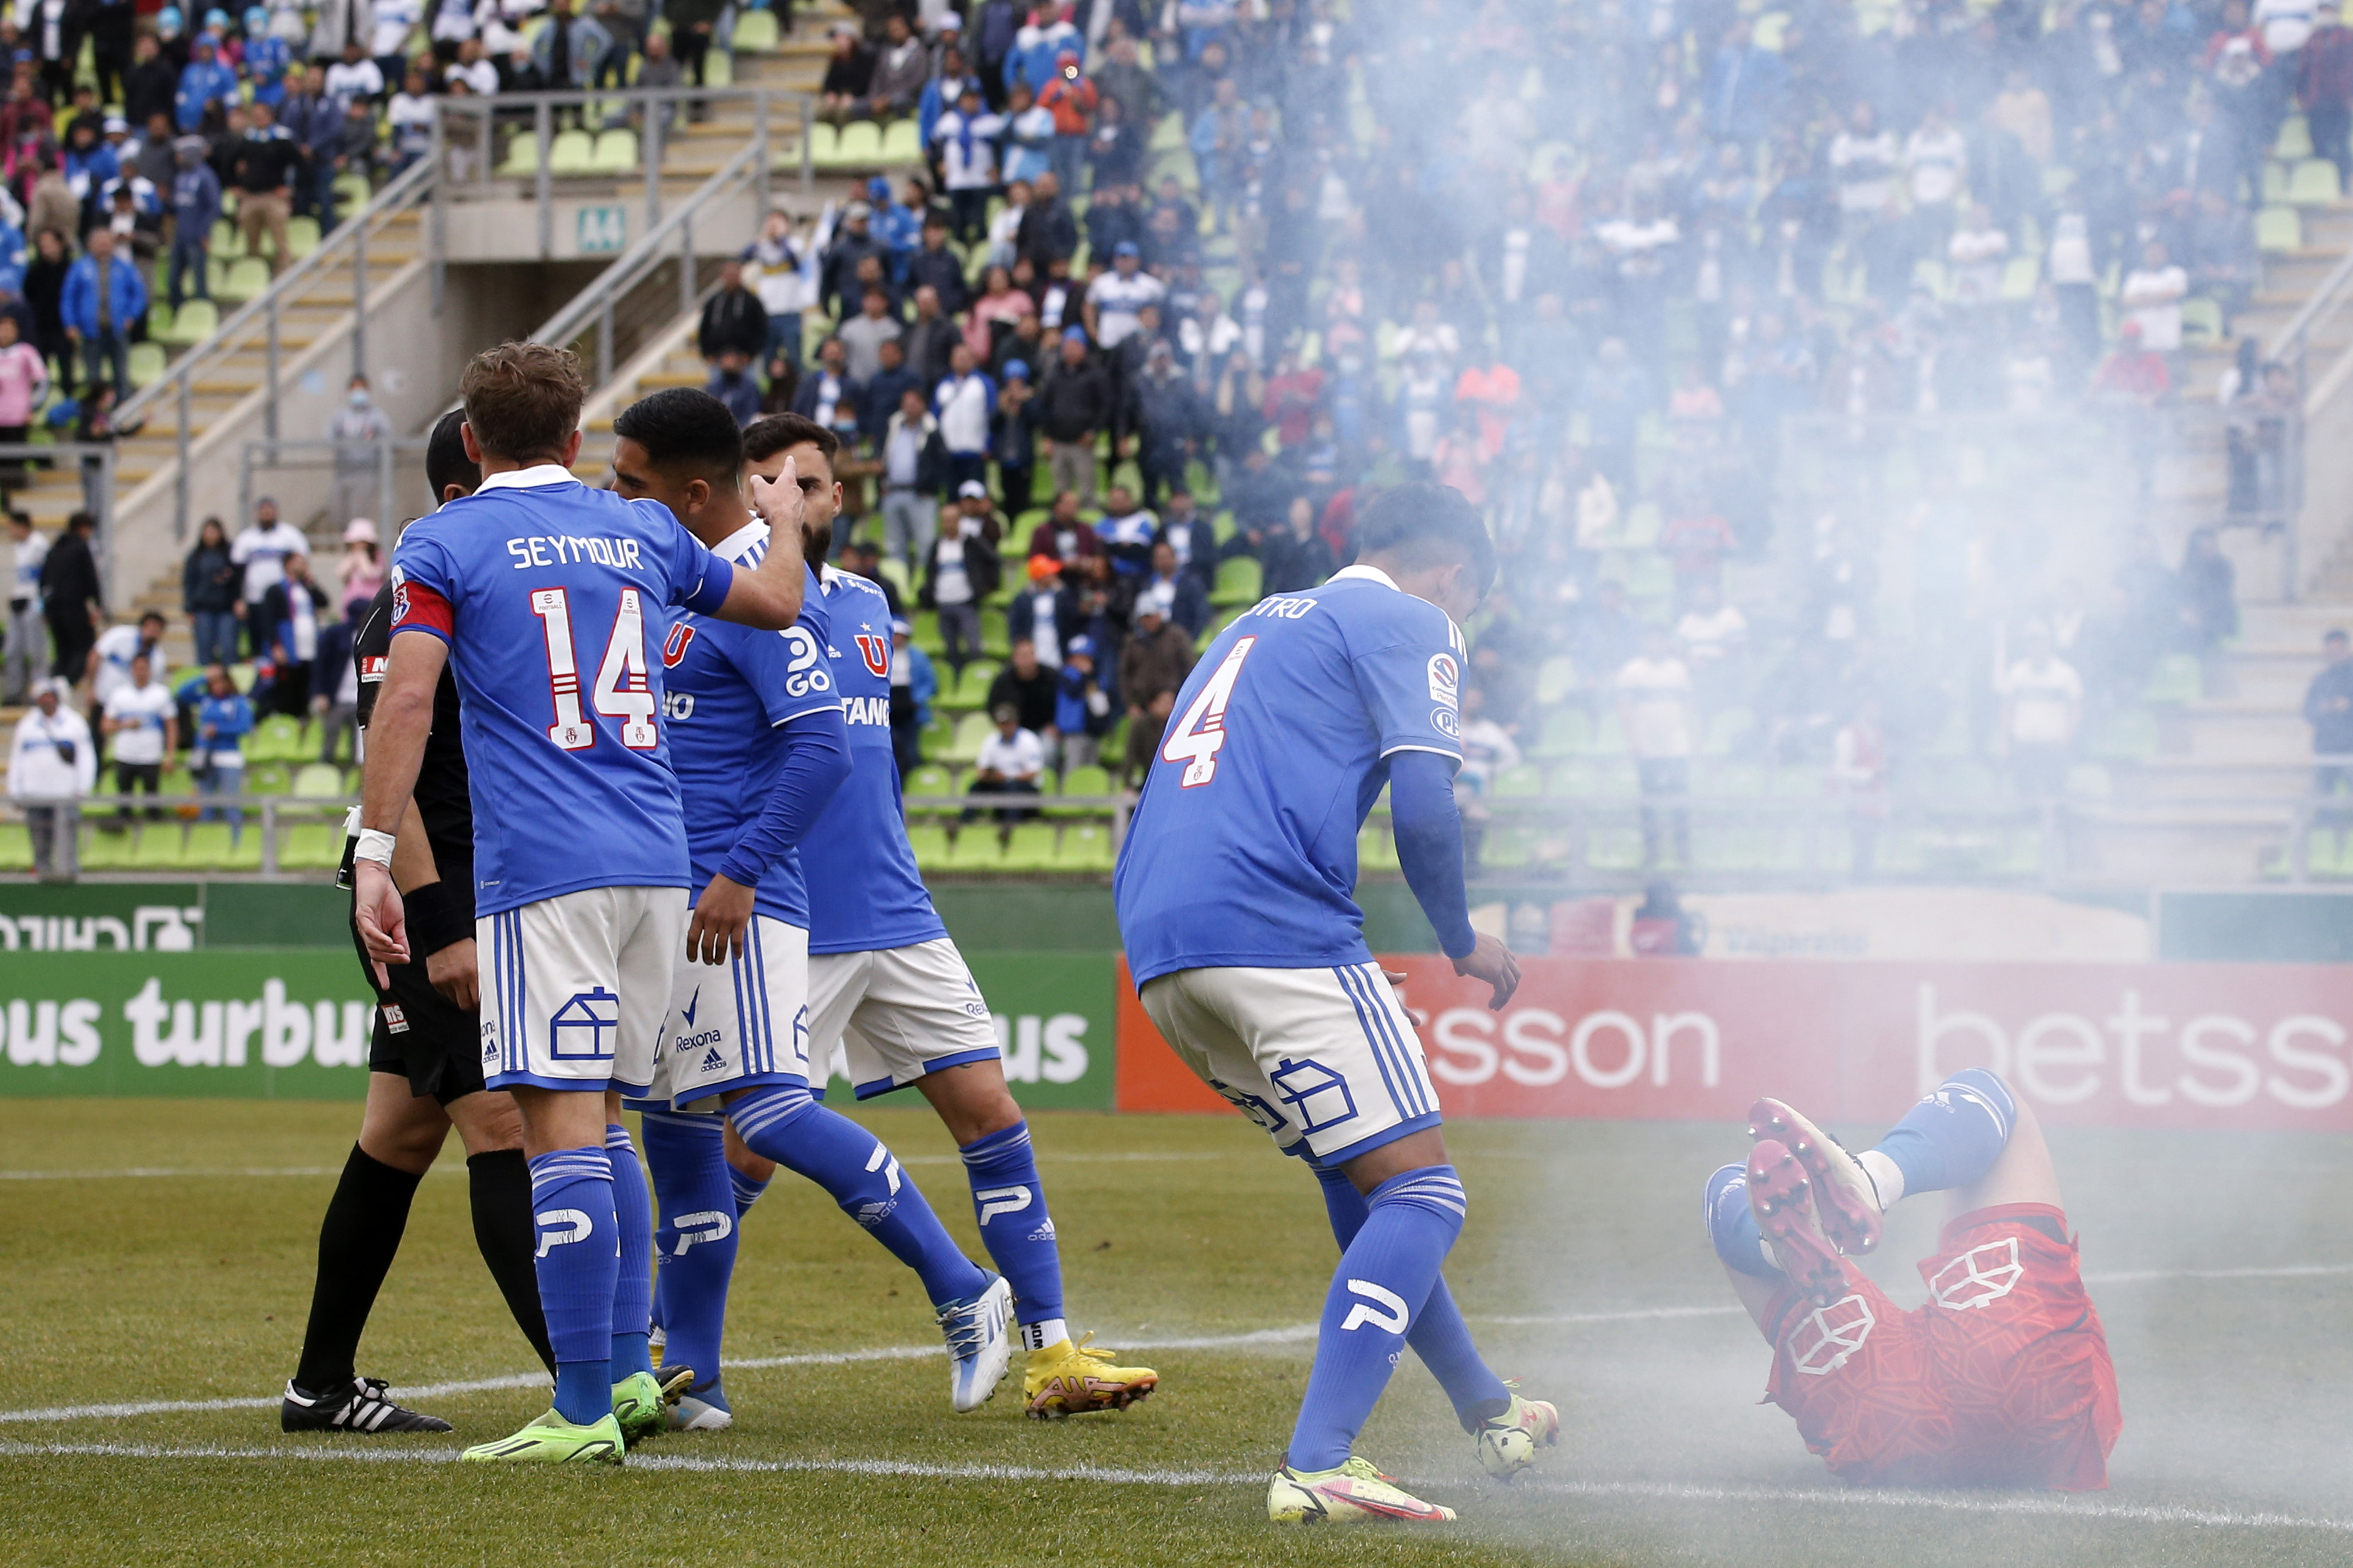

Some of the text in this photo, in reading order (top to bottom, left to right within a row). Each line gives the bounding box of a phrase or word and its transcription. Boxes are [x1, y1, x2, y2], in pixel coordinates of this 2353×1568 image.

[507, 535, 644, 570] SEYMOUR
[663, 621, 696, 669] U
[854, 635, 888, 678] U
[529, 586, 657, 750] 14
[785, 670, 830, 697] GO
[1161, 635, 1257, 789] 4
[124, 977, 380, 1068] turbu
[676, 1030, 721, 1053] Rexona
[1398, 988, 1719, 1088] sson
[481, 1053, 500, 1063] adidas
[701, 1061, 727, 1072] adidas
